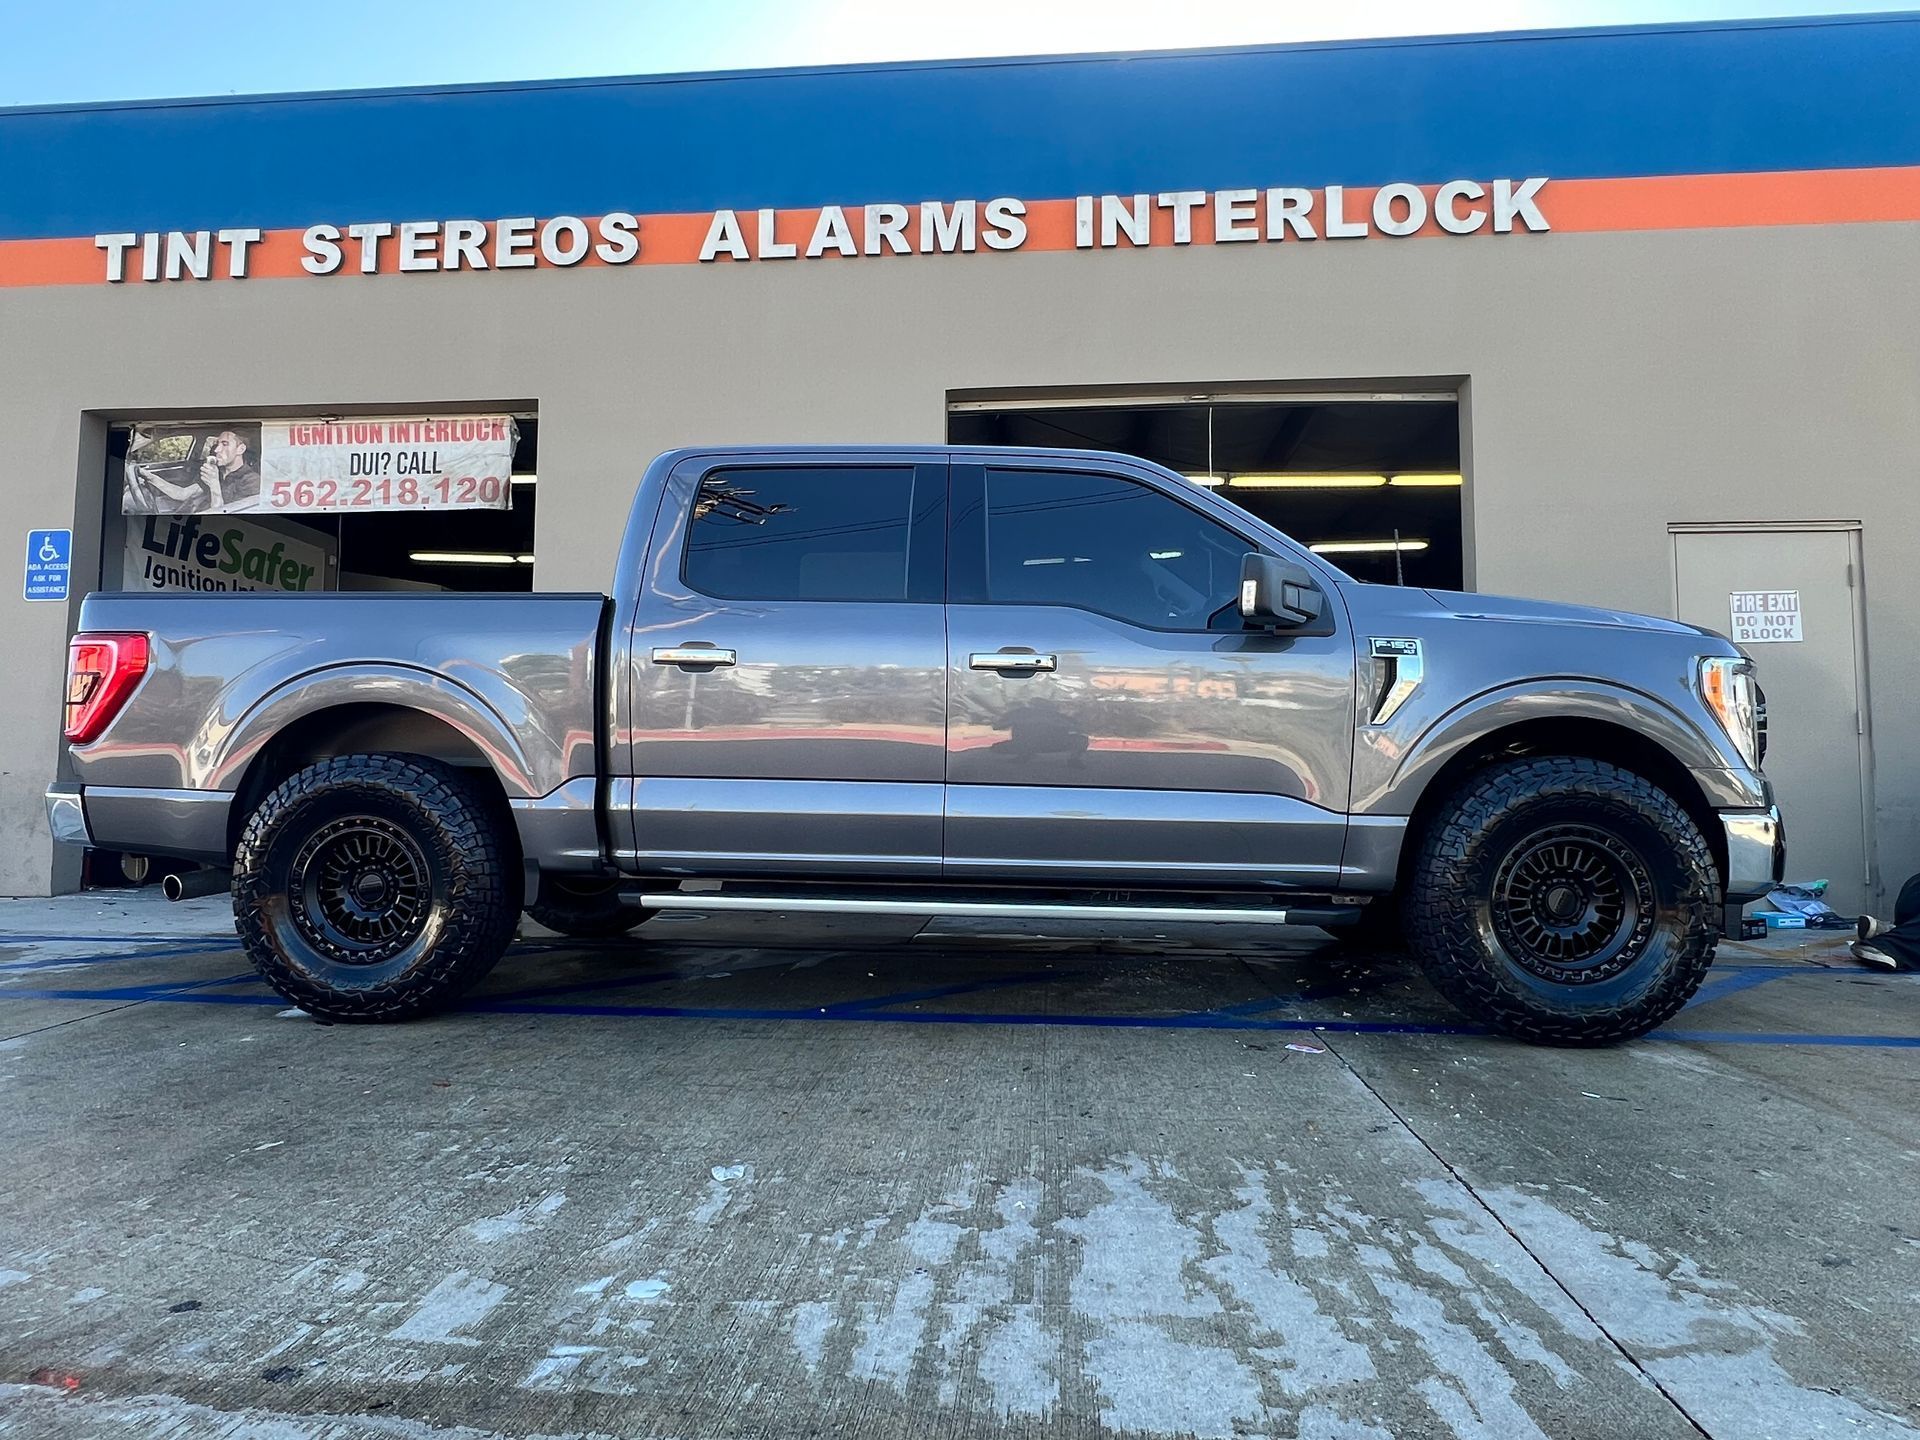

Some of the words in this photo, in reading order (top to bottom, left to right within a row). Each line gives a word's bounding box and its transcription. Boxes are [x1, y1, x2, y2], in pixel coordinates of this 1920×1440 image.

[95, 228, 262, 282] TINT
[301, 212, 640, 275] STEREOS
[698, 198, 1027, 261] ALARMS
[1076, 177, 1551, 248] INTERLOCK
[289, 422, 383, 446] IGNITION
[389, 417, 507, 444] INTERLOCK
[350, 452, 391, 476] DUI?
[397, 451, 442, 475] CALL
[141, 515, 314, 592] LifeSafer
[33, 574, 46, 582] ASK
[48, 574, 61, 582] FOR
[144, 556, 226, 592] Ignition
[1733, 594, 1764, 612] FIRE
[1767, 593, 1797, 611] EXIT
[1735, 615, 1758, 627] DO
[1763, 615, 1796, 626] NOT
[1375, 640, 1416, 650] F-150
[1740, 628, 1794, 640] BLOCK
